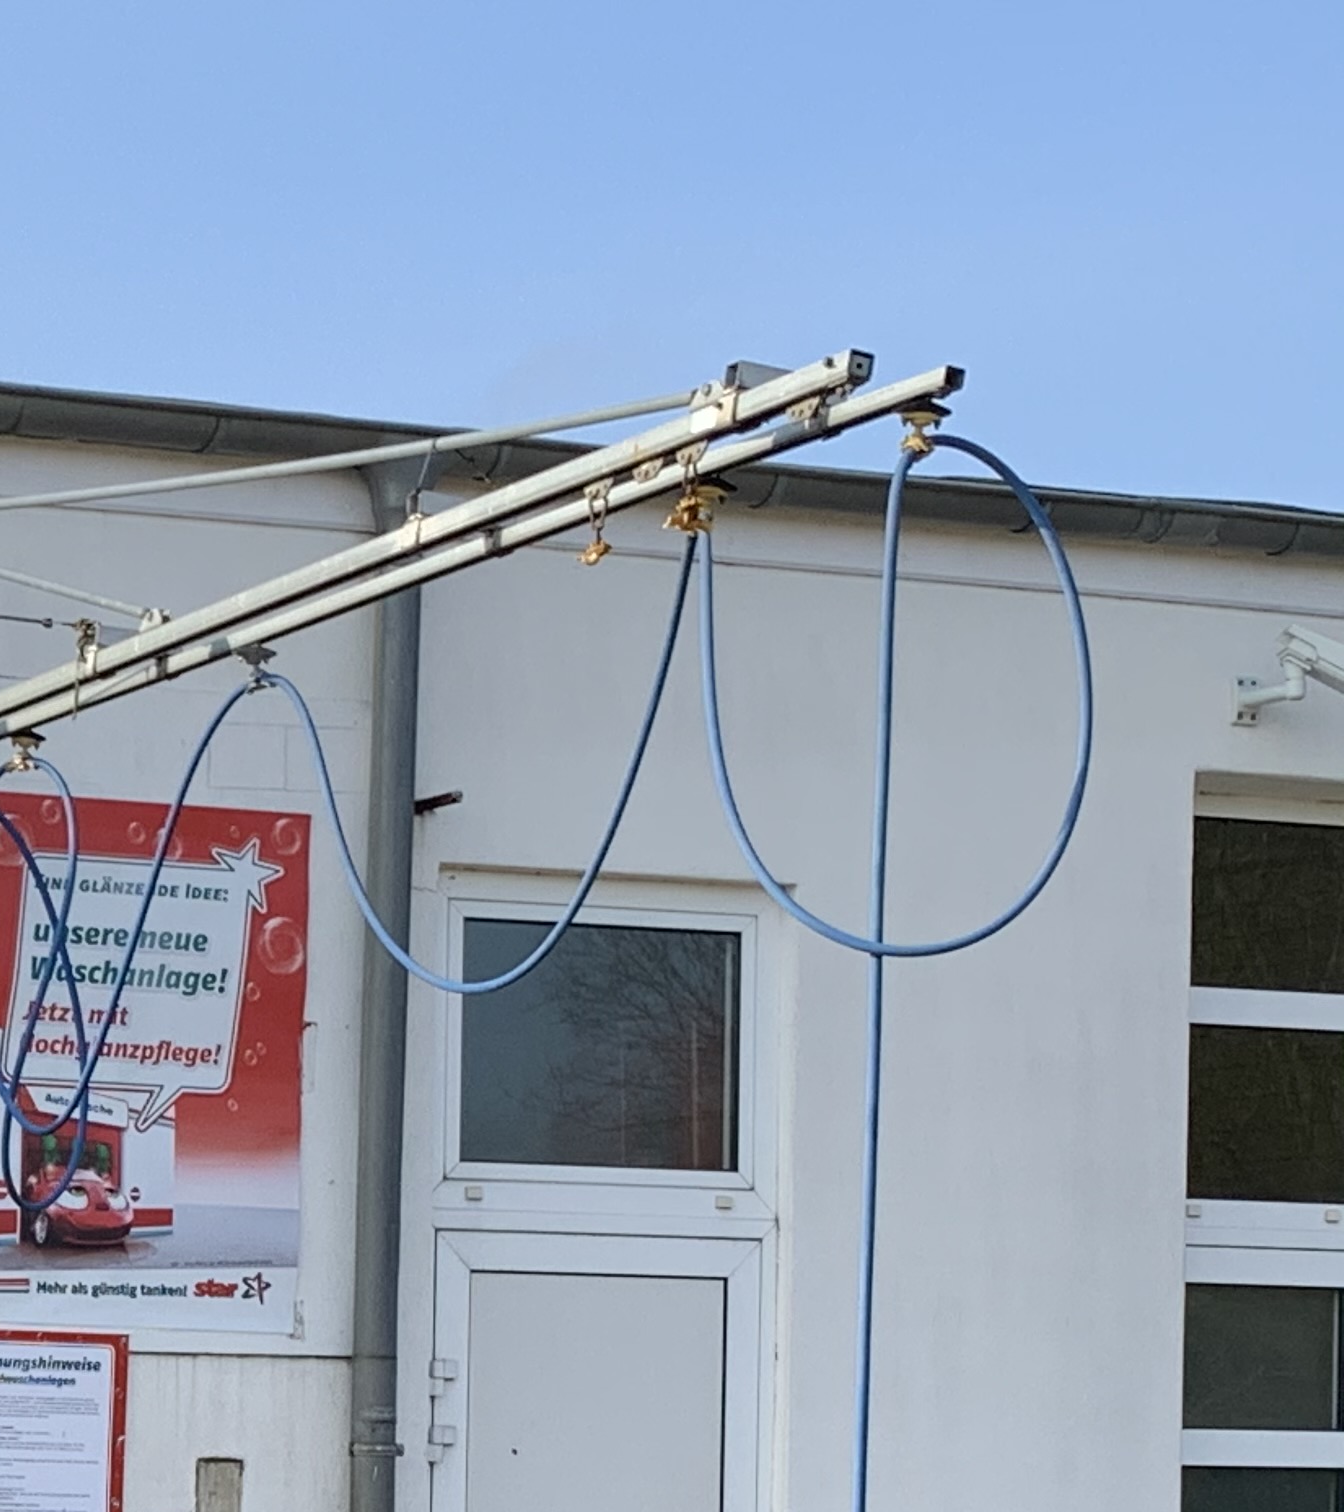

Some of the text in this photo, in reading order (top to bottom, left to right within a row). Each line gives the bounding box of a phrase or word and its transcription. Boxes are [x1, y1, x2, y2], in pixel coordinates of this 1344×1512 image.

[79, 876, 179, 899] GLÄNZEDE
[185, 883, 229, 902] IDEE:
[138, 929, 208, 952] neue
[36, 1278, 238, 1299] Mehr als günstig tanken! star
